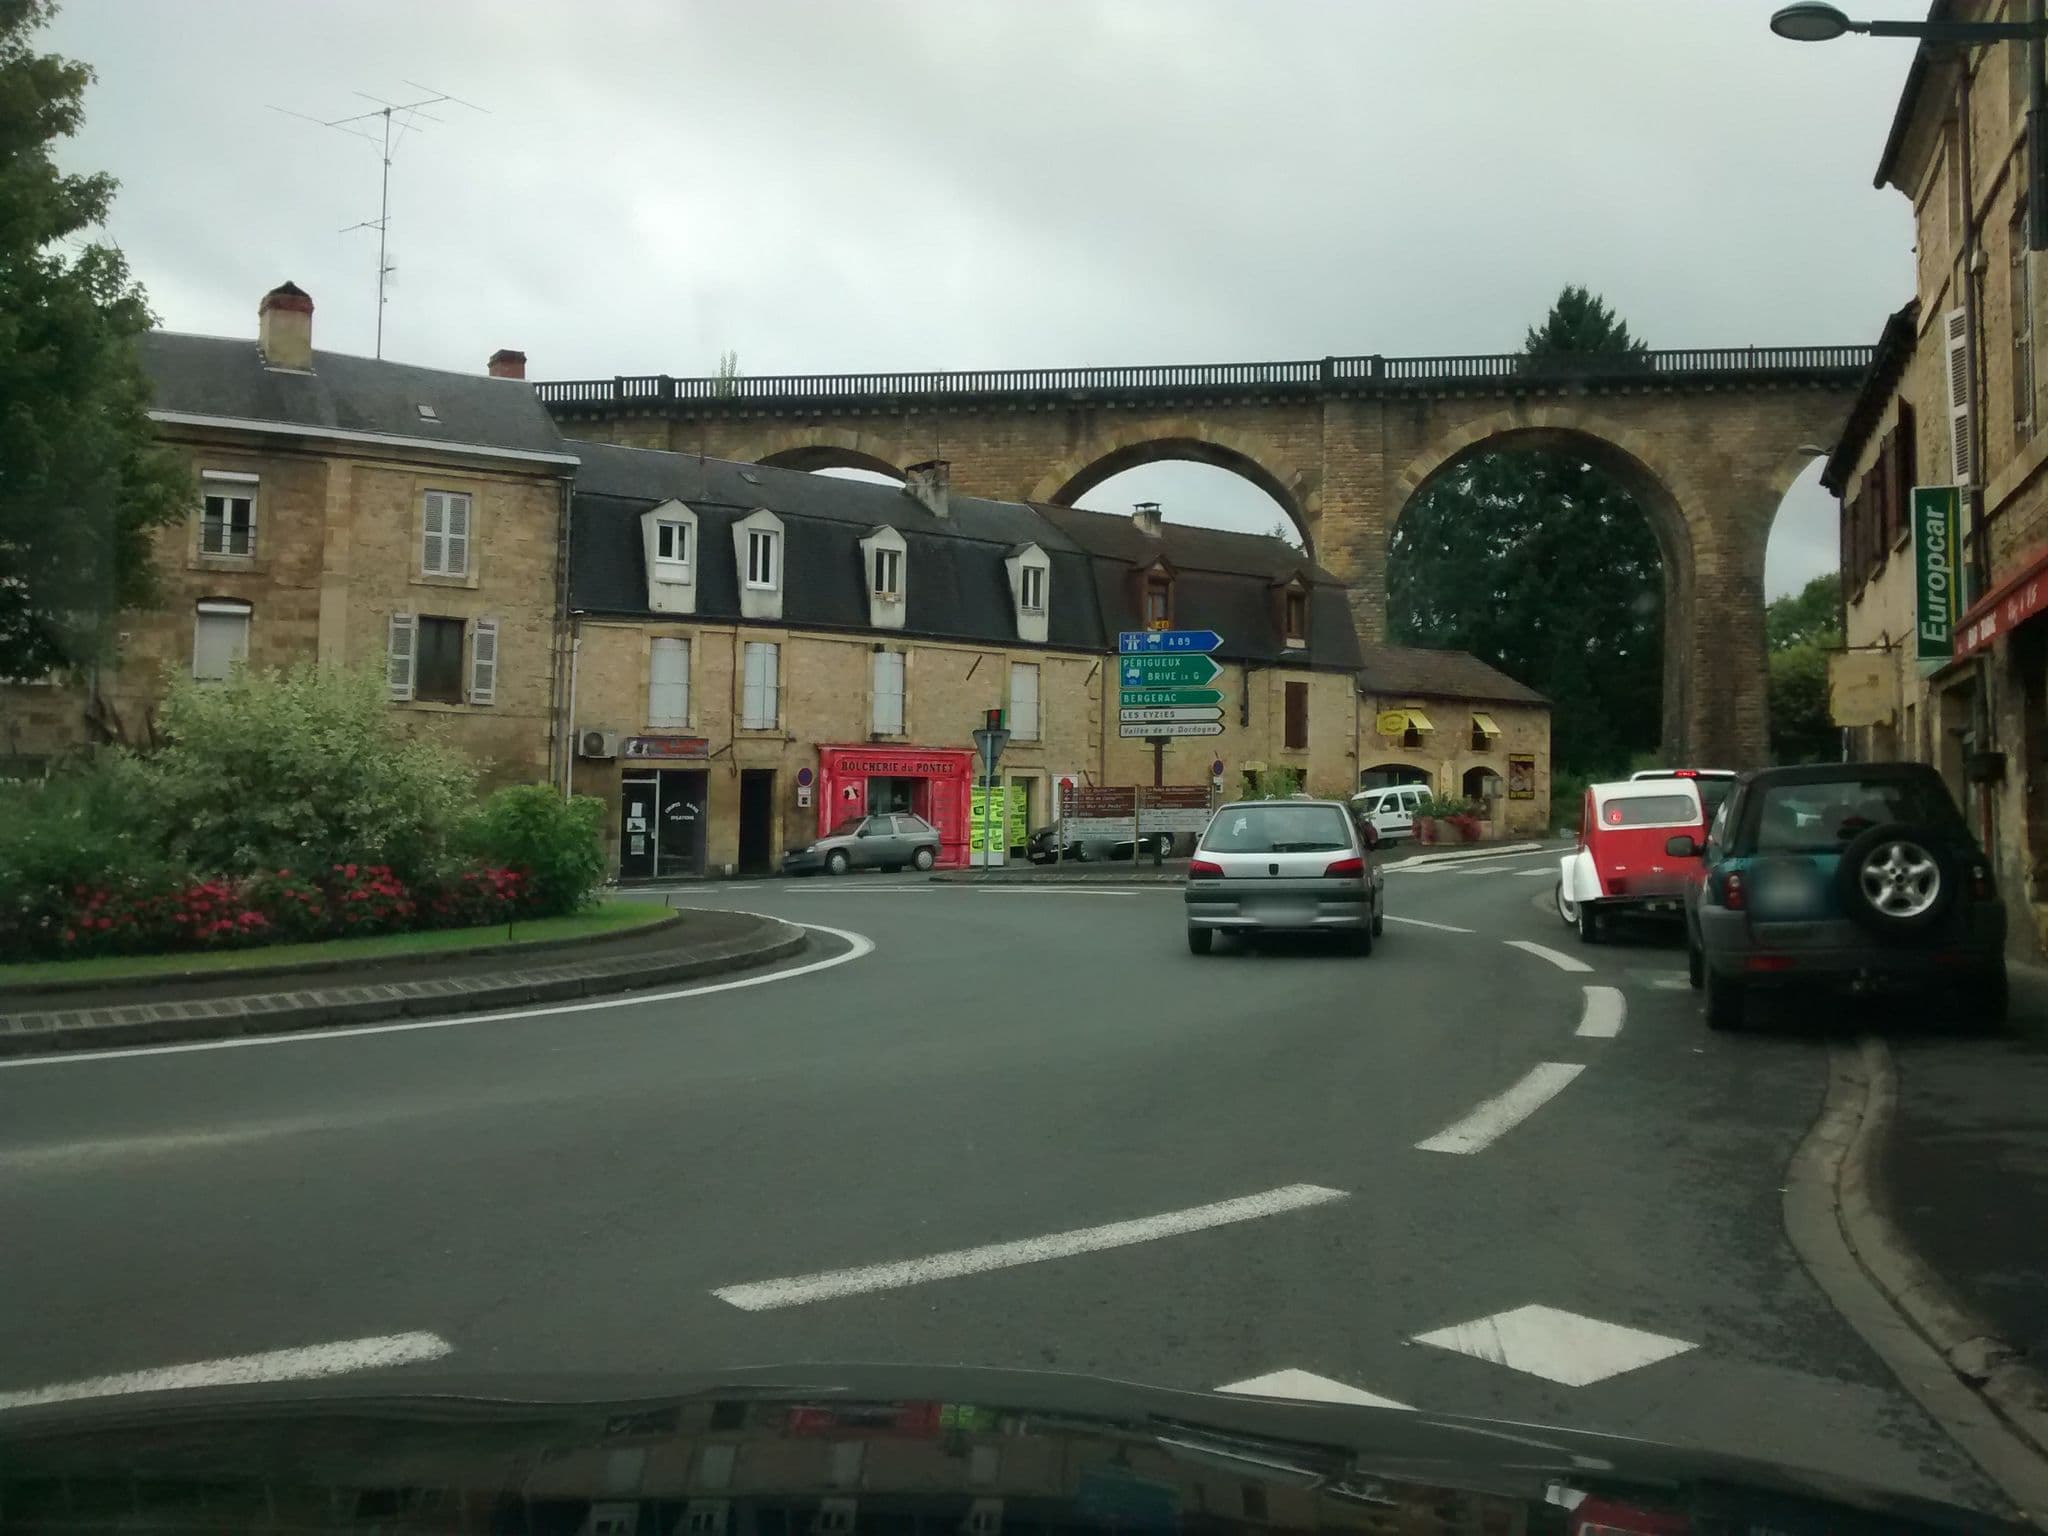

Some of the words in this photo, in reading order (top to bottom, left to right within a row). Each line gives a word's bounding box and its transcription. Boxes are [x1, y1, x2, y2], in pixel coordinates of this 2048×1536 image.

[1922, 505, 1952, 643] Europcar
[1168, 637, 1175, 646] A
[1177, 637, 1191, 646] 89
[1123, 657, 1181, 667] PÉRIGUEUX
[1147, 672, 1177, 681] BRIVE
[1123, 694, 1177, 703] BERGERAC
[1122, 711, 1139, 719] LES
[1143, 710, 1175, 718] EYZIES
[1177, 726, 1217, 735] Dordogne
[841, 761, 899, 772] BOUCHERIE
[901, 762, 913, 772] du
[916, 762, 954, 773] PONTET
